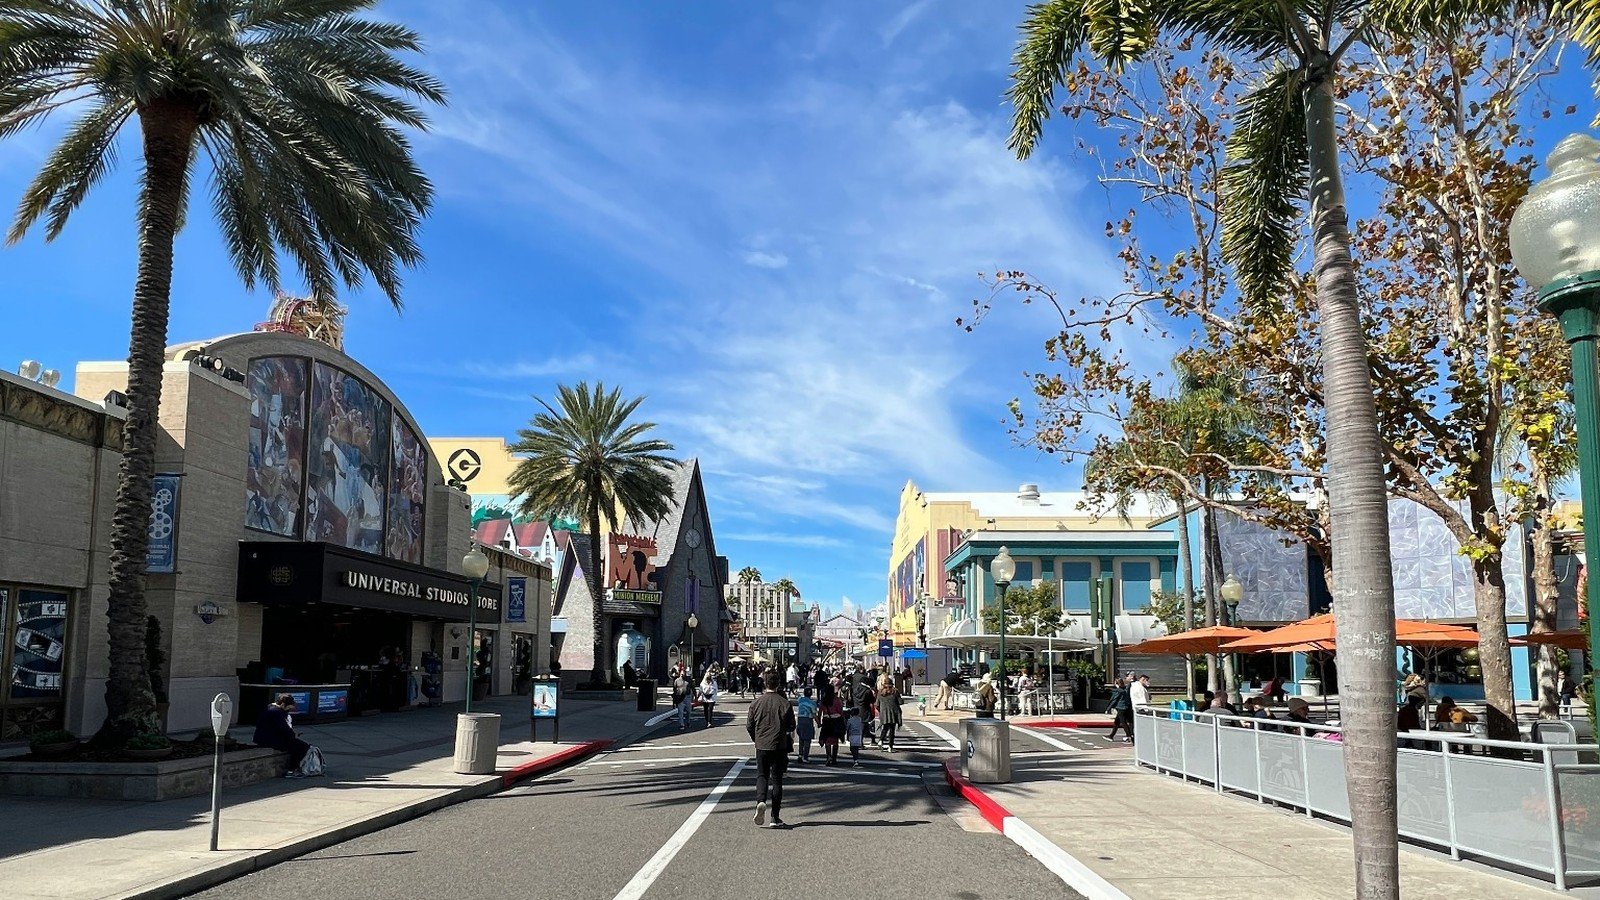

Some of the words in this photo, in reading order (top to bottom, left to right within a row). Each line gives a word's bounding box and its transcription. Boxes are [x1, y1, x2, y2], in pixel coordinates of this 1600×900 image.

[348, 570, 422, 599] UNIVERSAL
[426, 586, 469, 606] STUDIOS
[477, 595, 498, 610] TORE
